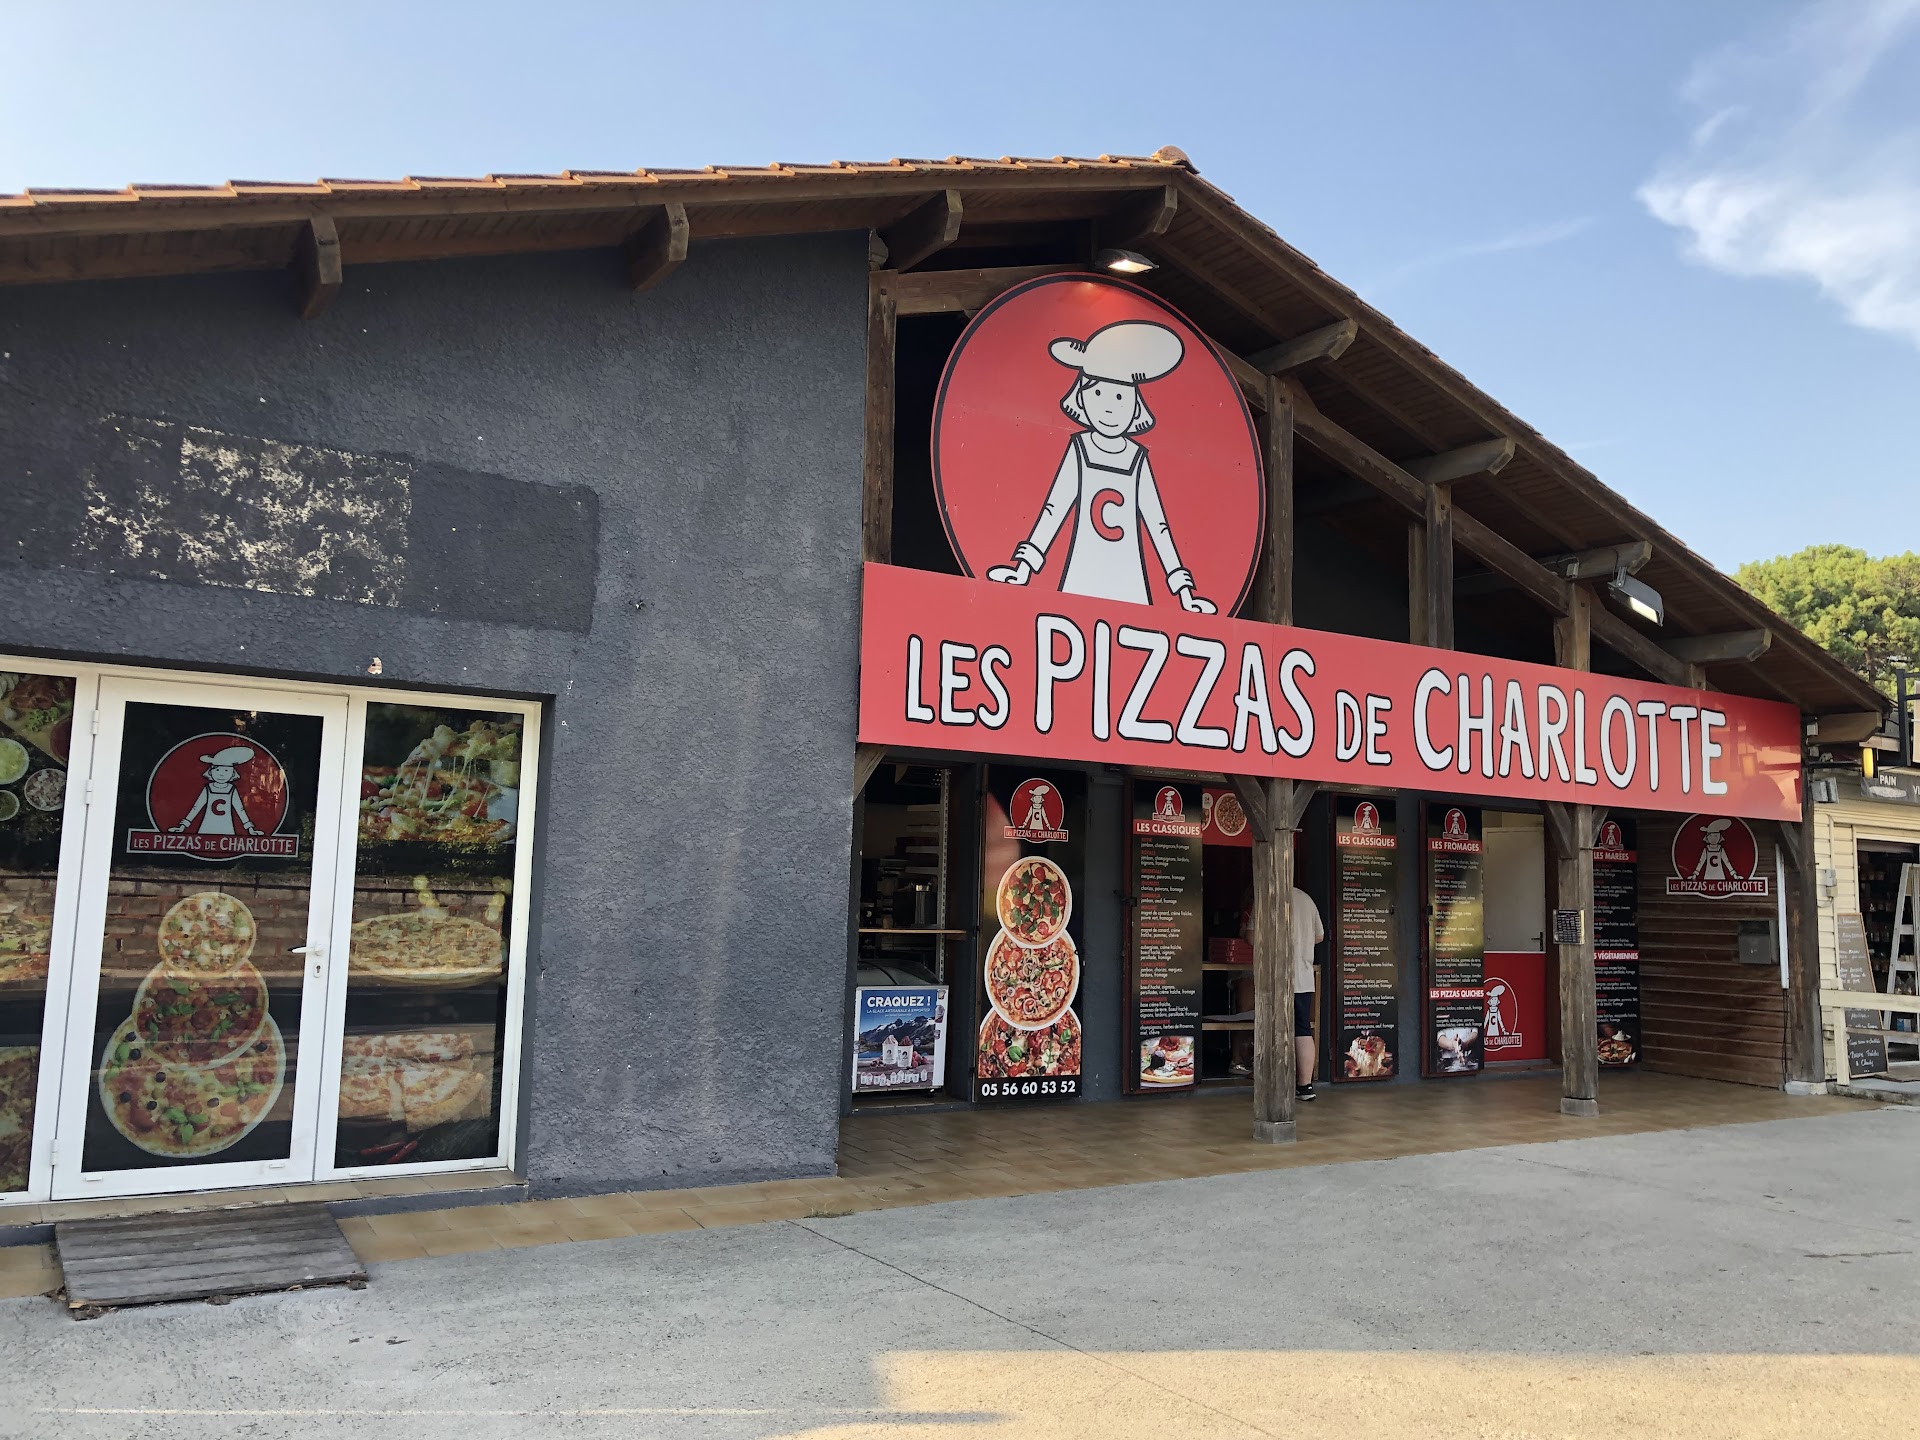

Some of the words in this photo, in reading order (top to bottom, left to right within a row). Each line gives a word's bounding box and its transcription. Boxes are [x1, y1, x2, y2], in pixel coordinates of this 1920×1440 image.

[1090, 488, 1124, 541] C
[906, 634, 1012, 730] LES
[1034, 613, 1316, 758] PIZZAS
[1335, 689, 1392, 766] DE
[1414, 666, 1728, 797] CHARLOTTE
[1879, 774, 1897, 786] PAIN
[1038, 830, 1066, 839] CHARLOTTE
[1136, 823, 1150, 832] LES
[1152, 824, 1200, 835] CLASSIQUES
[133, 838, 149, 849] LES
[153, 835, 202, 850] PIZZAS
[204, 840, 216, 849] DE
[219, 837, 294, 853] CHARLOTTE
[1338, 836, 1350, 844] LES
[1352, 836, 1395, 846] CLASSIQUES
[1432, 841, 1442, 849] LES
[1444, 842, 1479, 852] FROMAGES
[1680, 881, 1707, 891] PIZZAS
[1717, 881, 1763, 892] CHARLOTTE
[867, 996, 924, 1008] CRAQUEZ
[1494, 1036, 1520, 1045] CHARLOTTE
[981, 1083, 998, 1096] 05
[1002, 1082, 1018, 1096] 56
[1021, 1082, 1038, 1094] 60
[1041, 1081, 1056, 1094] 53
[1060, 1080, 1076, 1093] 52
